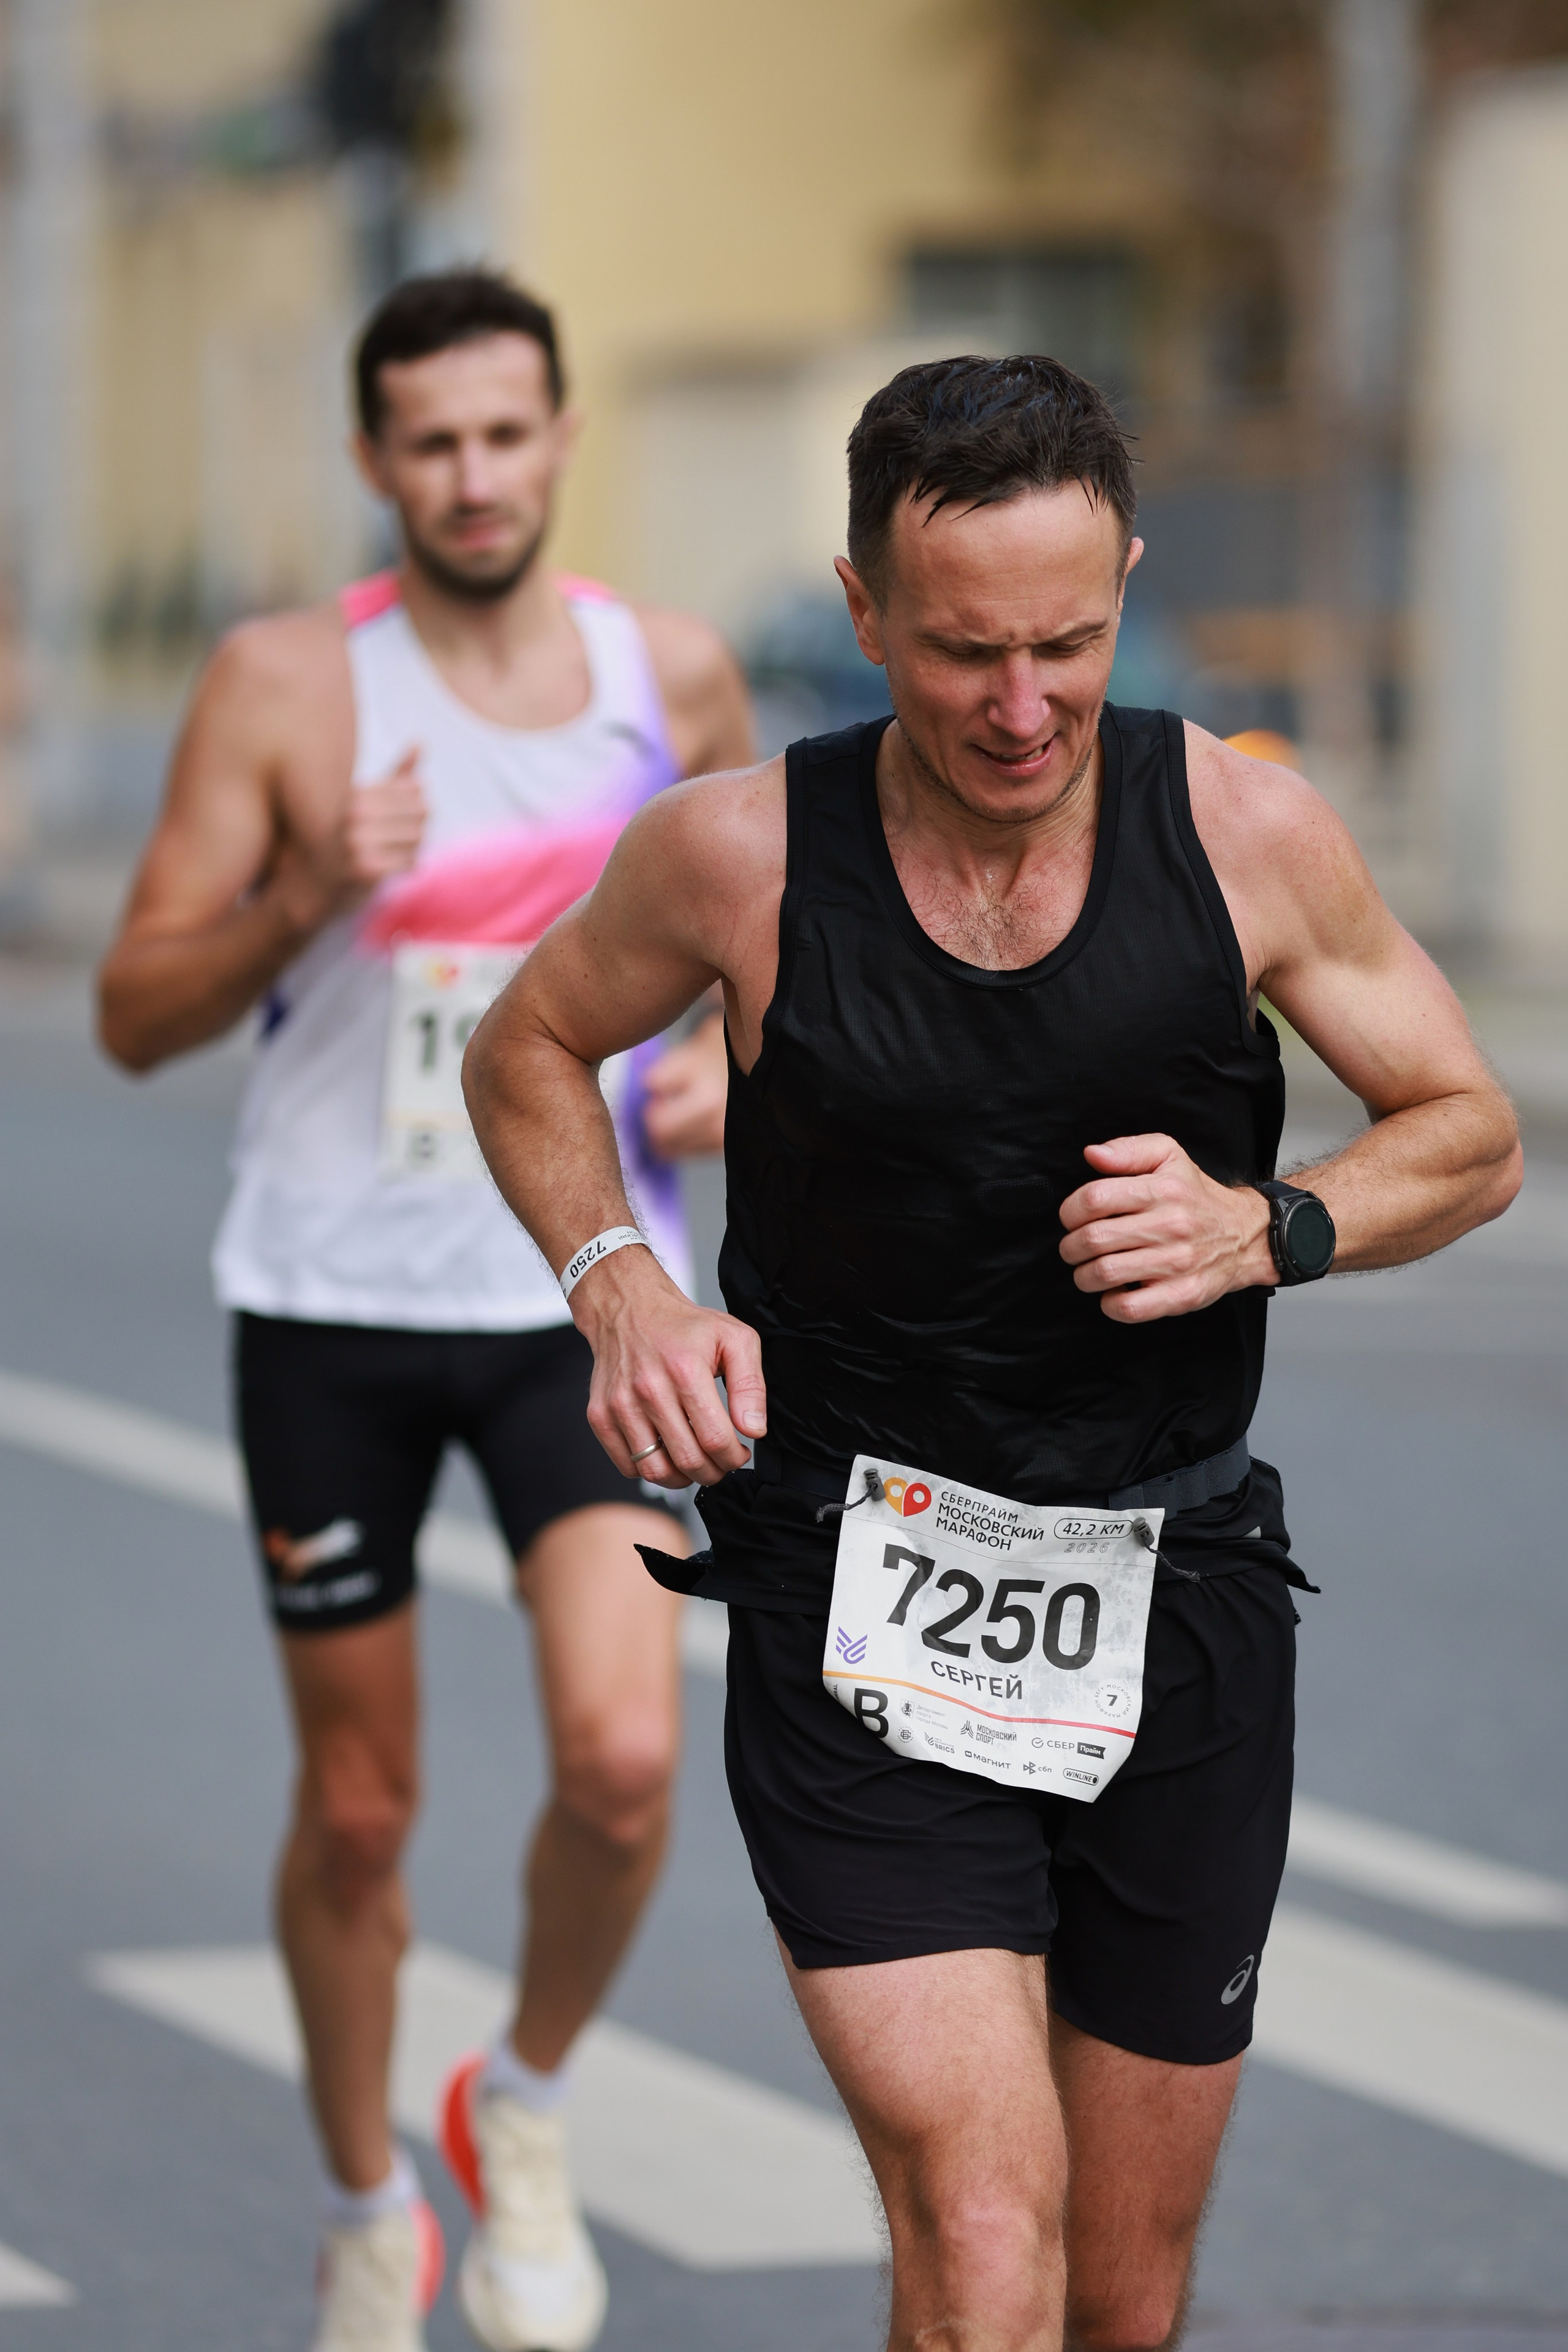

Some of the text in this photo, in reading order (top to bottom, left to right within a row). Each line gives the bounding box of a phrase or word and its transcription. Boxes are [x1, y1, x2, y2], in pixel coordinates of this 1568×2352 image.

[570, 1241, 607, 1278] 7250
[941, 1491, 1019, 1523] СБЕРПРАЙМ
[938, 1502, 1044, 1540] МОСКОВСКИЙ
[936, 1517, 1012, 1550] МАРАФОН
[1063, 1523, 1096, 1537] 42,2
[1064, 1542, 1110, 1553] 2026
[882, 1544, 1101, 1671] 7250
[930, 1660, 1023, 1700] СЕРГЕЙ
[1106, 1694, 1118, 1706] 7
[976, 1733, 994, 1746] СПОРТ
[977, 1724, 1017, 1741] МОСКОВСКИЙ
[935, 1743, 955, 1754] BRICS
[1047, 1740, 1101, 1755] СБЕР Прайм
[1066, 1770, 1093, 1783] WINLINE
